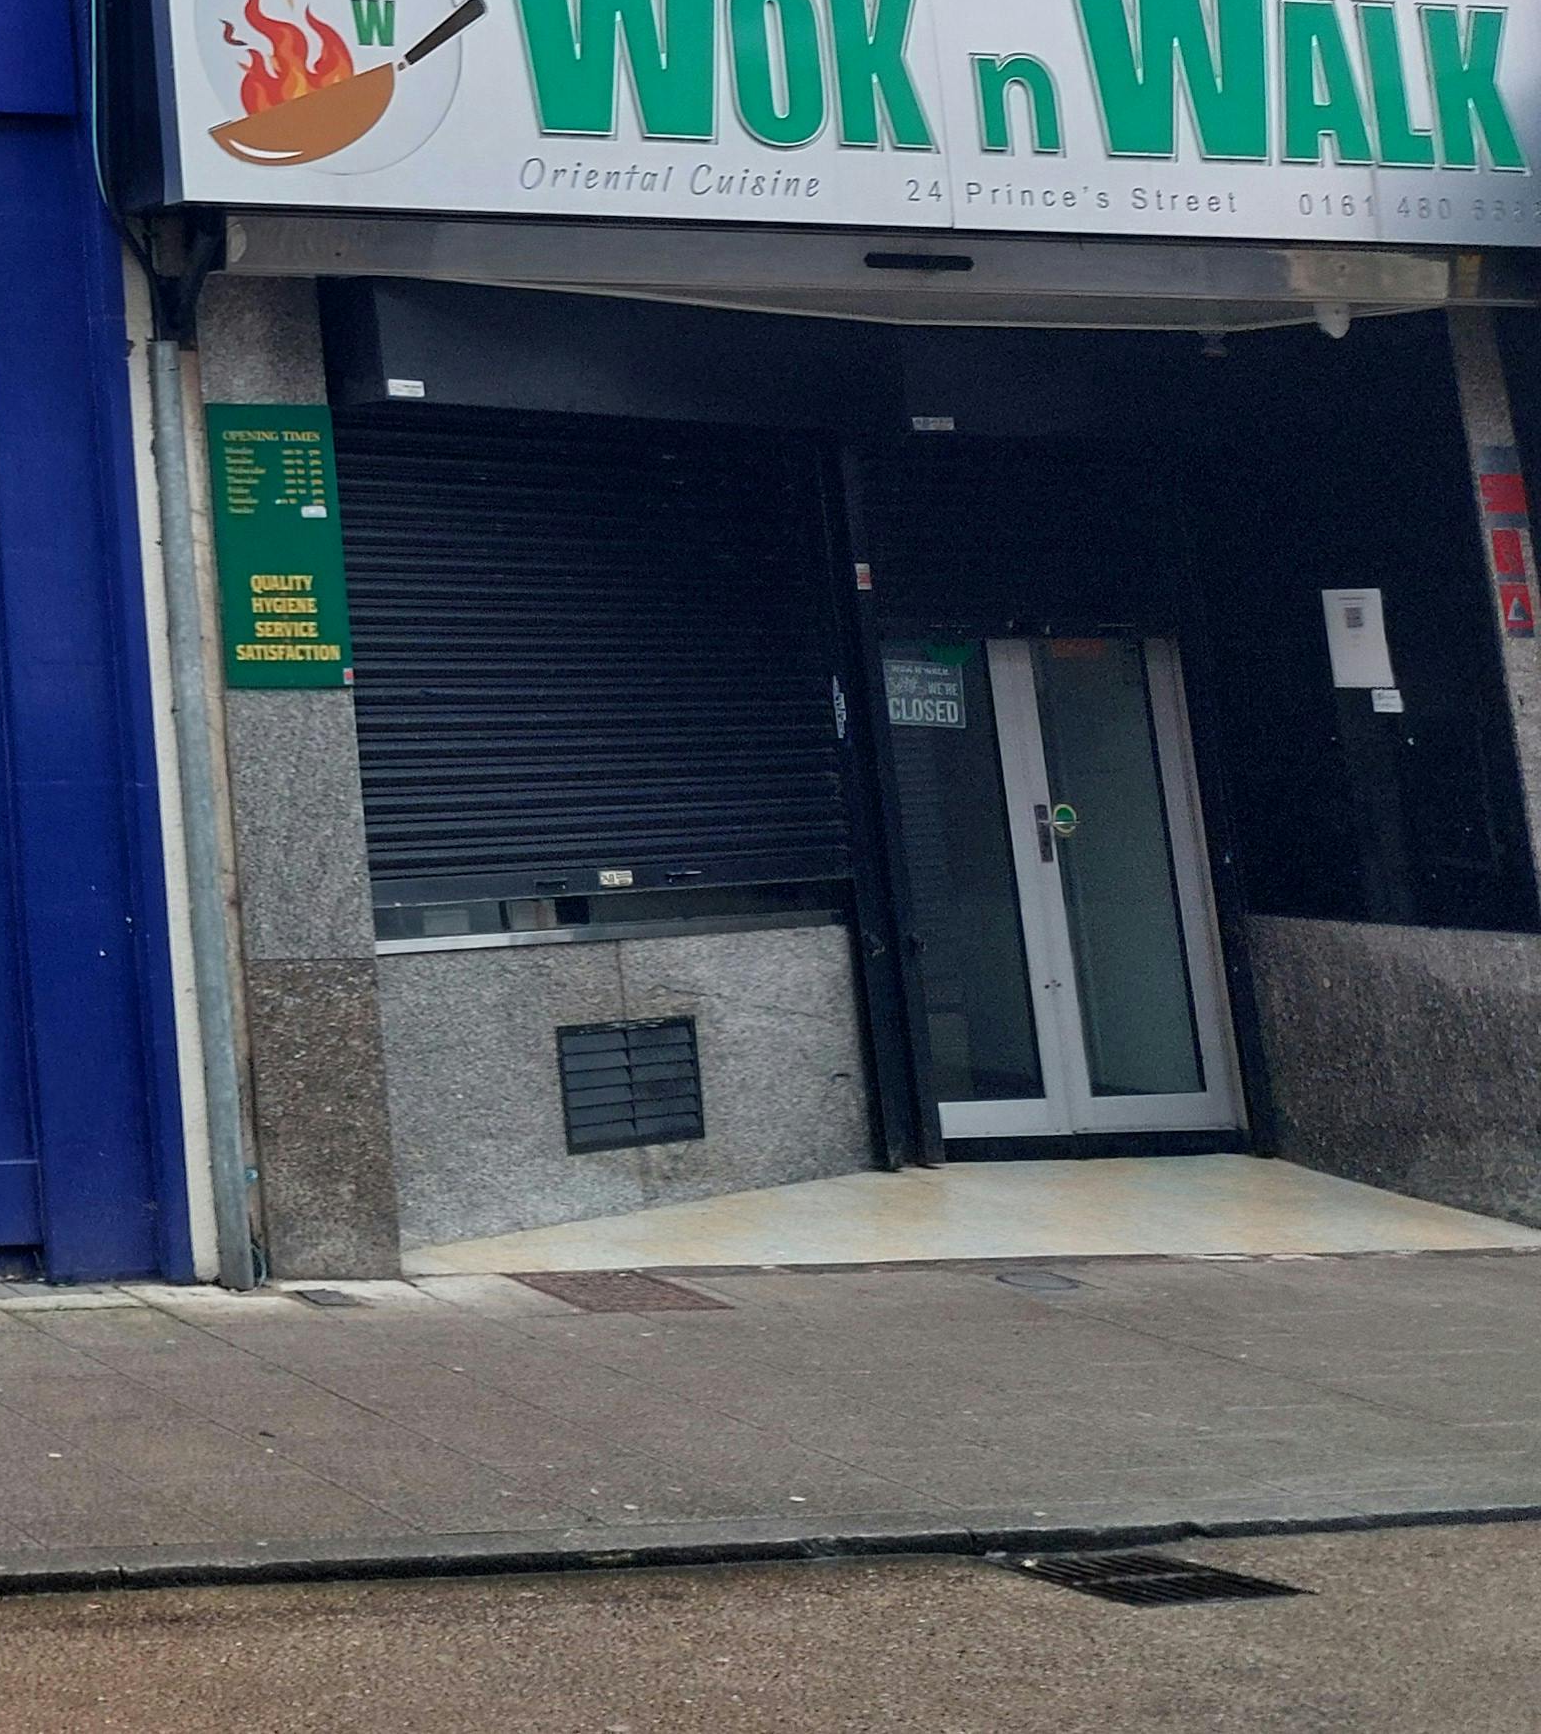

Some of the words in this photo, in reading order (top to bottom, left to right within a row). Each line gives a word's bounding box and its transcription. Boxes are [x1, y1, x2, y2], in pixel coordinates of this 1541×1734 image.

[968, 51, 1067, 158] n
[519, 157, 674, 194] Oriental
[689, 163, 821, 199] Cuisine
[905, 178, 943, 203] 24
[965, 181, 1111, 210] Prince's
[1130, 187, 1238, 214] Street
[1299, 192, 1375, 217] 0161
[222, 430, 279, 442] OPENING
[280, 430, 321, 442] TIMES
[250, 574, 313, 595] QUALITY
[251, 597, 318, 614] HYGIENE
[254, 621, 319, 638] SERVICE
[236, 644, 341, 662] SATISFACTION
[888, 697, 959, 723] CLOSED
